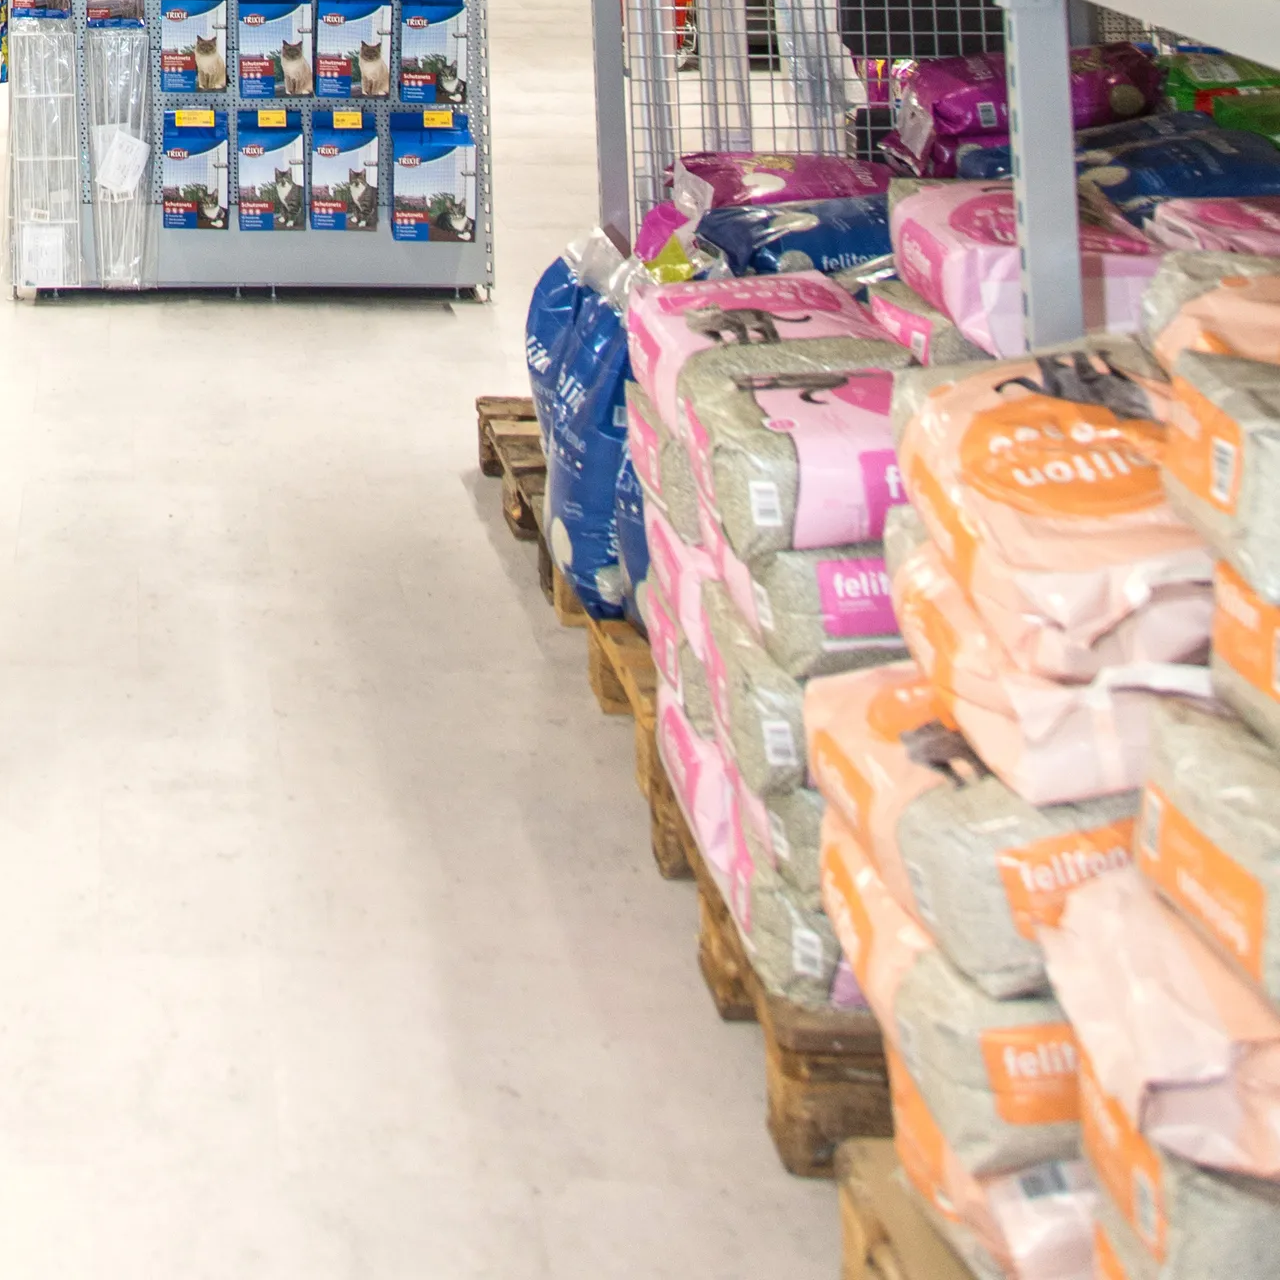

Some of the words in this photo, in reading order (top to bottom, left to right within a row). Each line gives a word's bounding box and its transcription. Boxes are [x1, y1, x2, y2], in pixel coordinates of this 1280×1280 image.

[166, 11, 188, 20] TRIXIE
[243, 15, 266, 24] TRIXIE
[322, 15, 345, 24] TRIXIE
[406, 18, 429, 27] TRIXIE
[166, 150, 189, 159] TRIXIE
[241, 146, 264, 156] TRIXIE
[316, 147, 340, 156] TRIXIE
[398, 157, 421, 166] TRIXIE
[821, 252, 878, 271] felito
[832, 570, 891, 598] felit
[1003, 1044, 1077, 1077] felit
